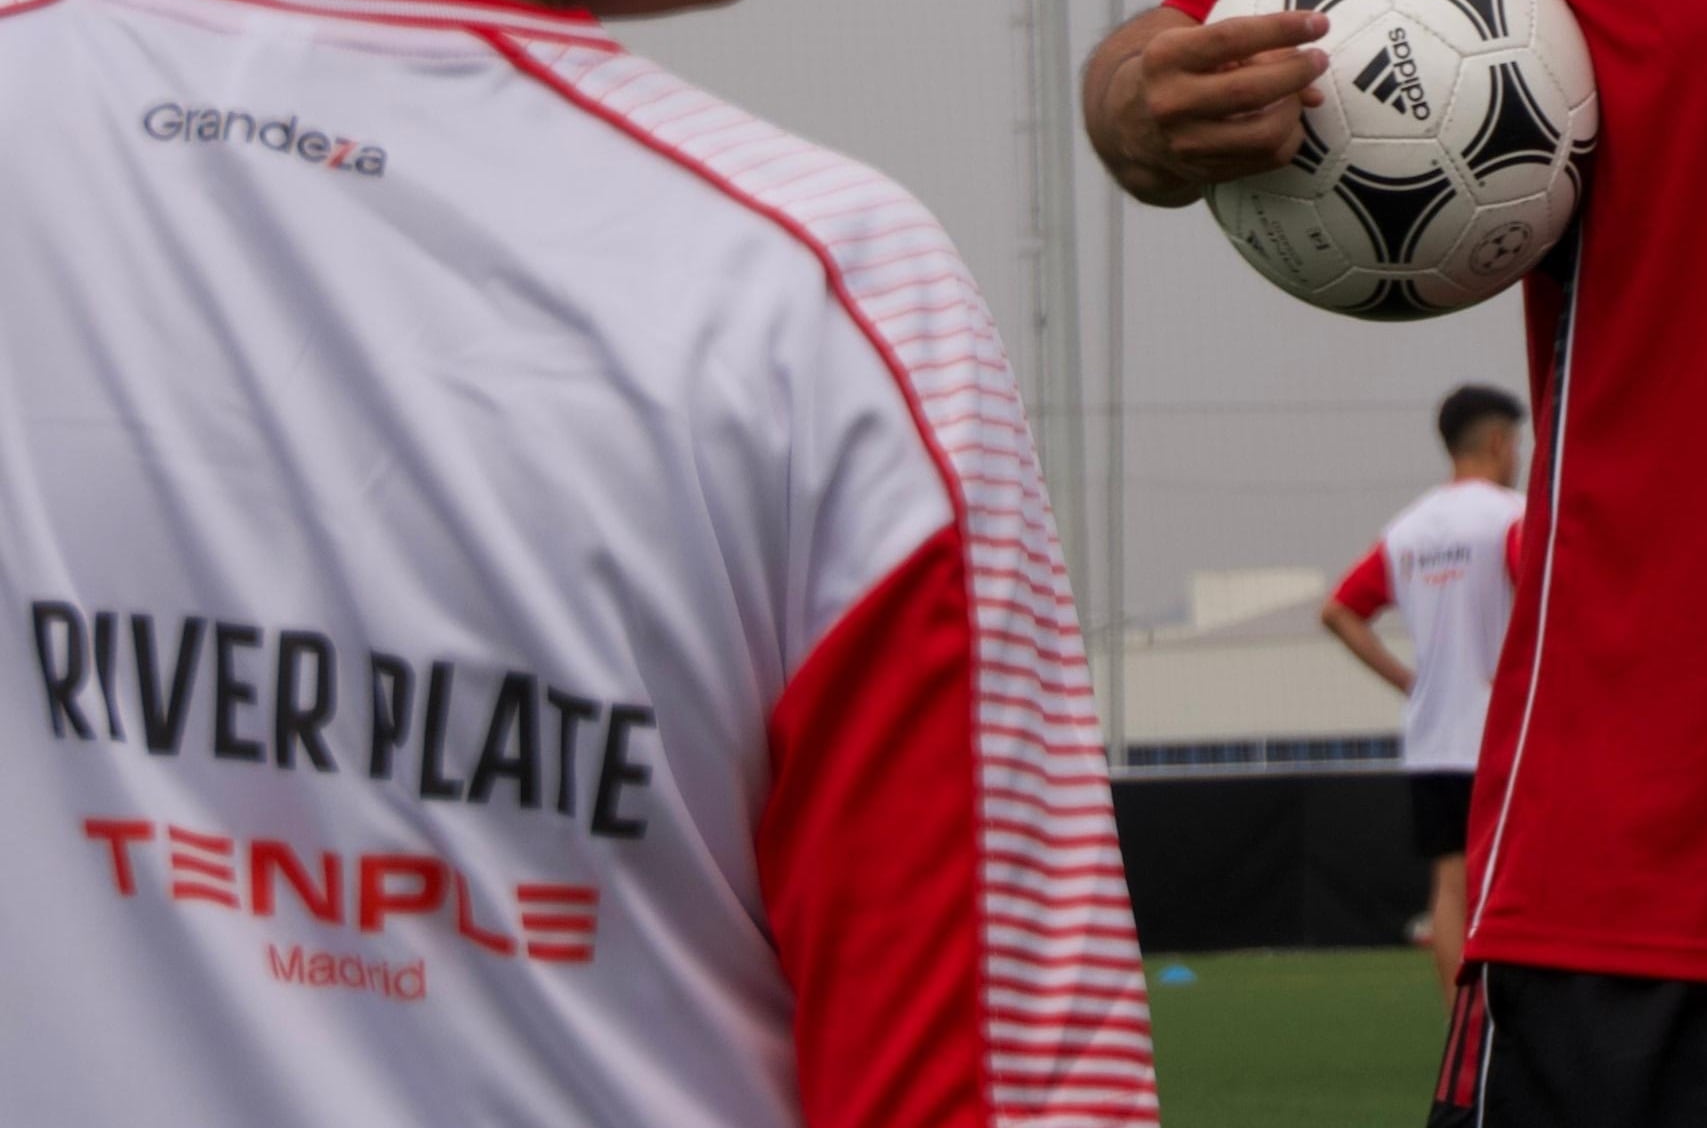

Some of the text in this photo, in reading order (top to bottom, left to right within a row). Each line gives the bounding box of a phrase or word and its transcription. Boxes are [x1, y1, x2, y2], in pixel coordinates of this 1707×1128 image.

[1388, 27, 1431, 121] adidas
[143, 102, 388, 178] Grandeza
[31, 600, 659, 841] RIVER PLATE
[82, 816, 600, 964] TENPLE
[267, 942, 427, 1001] Madrid
